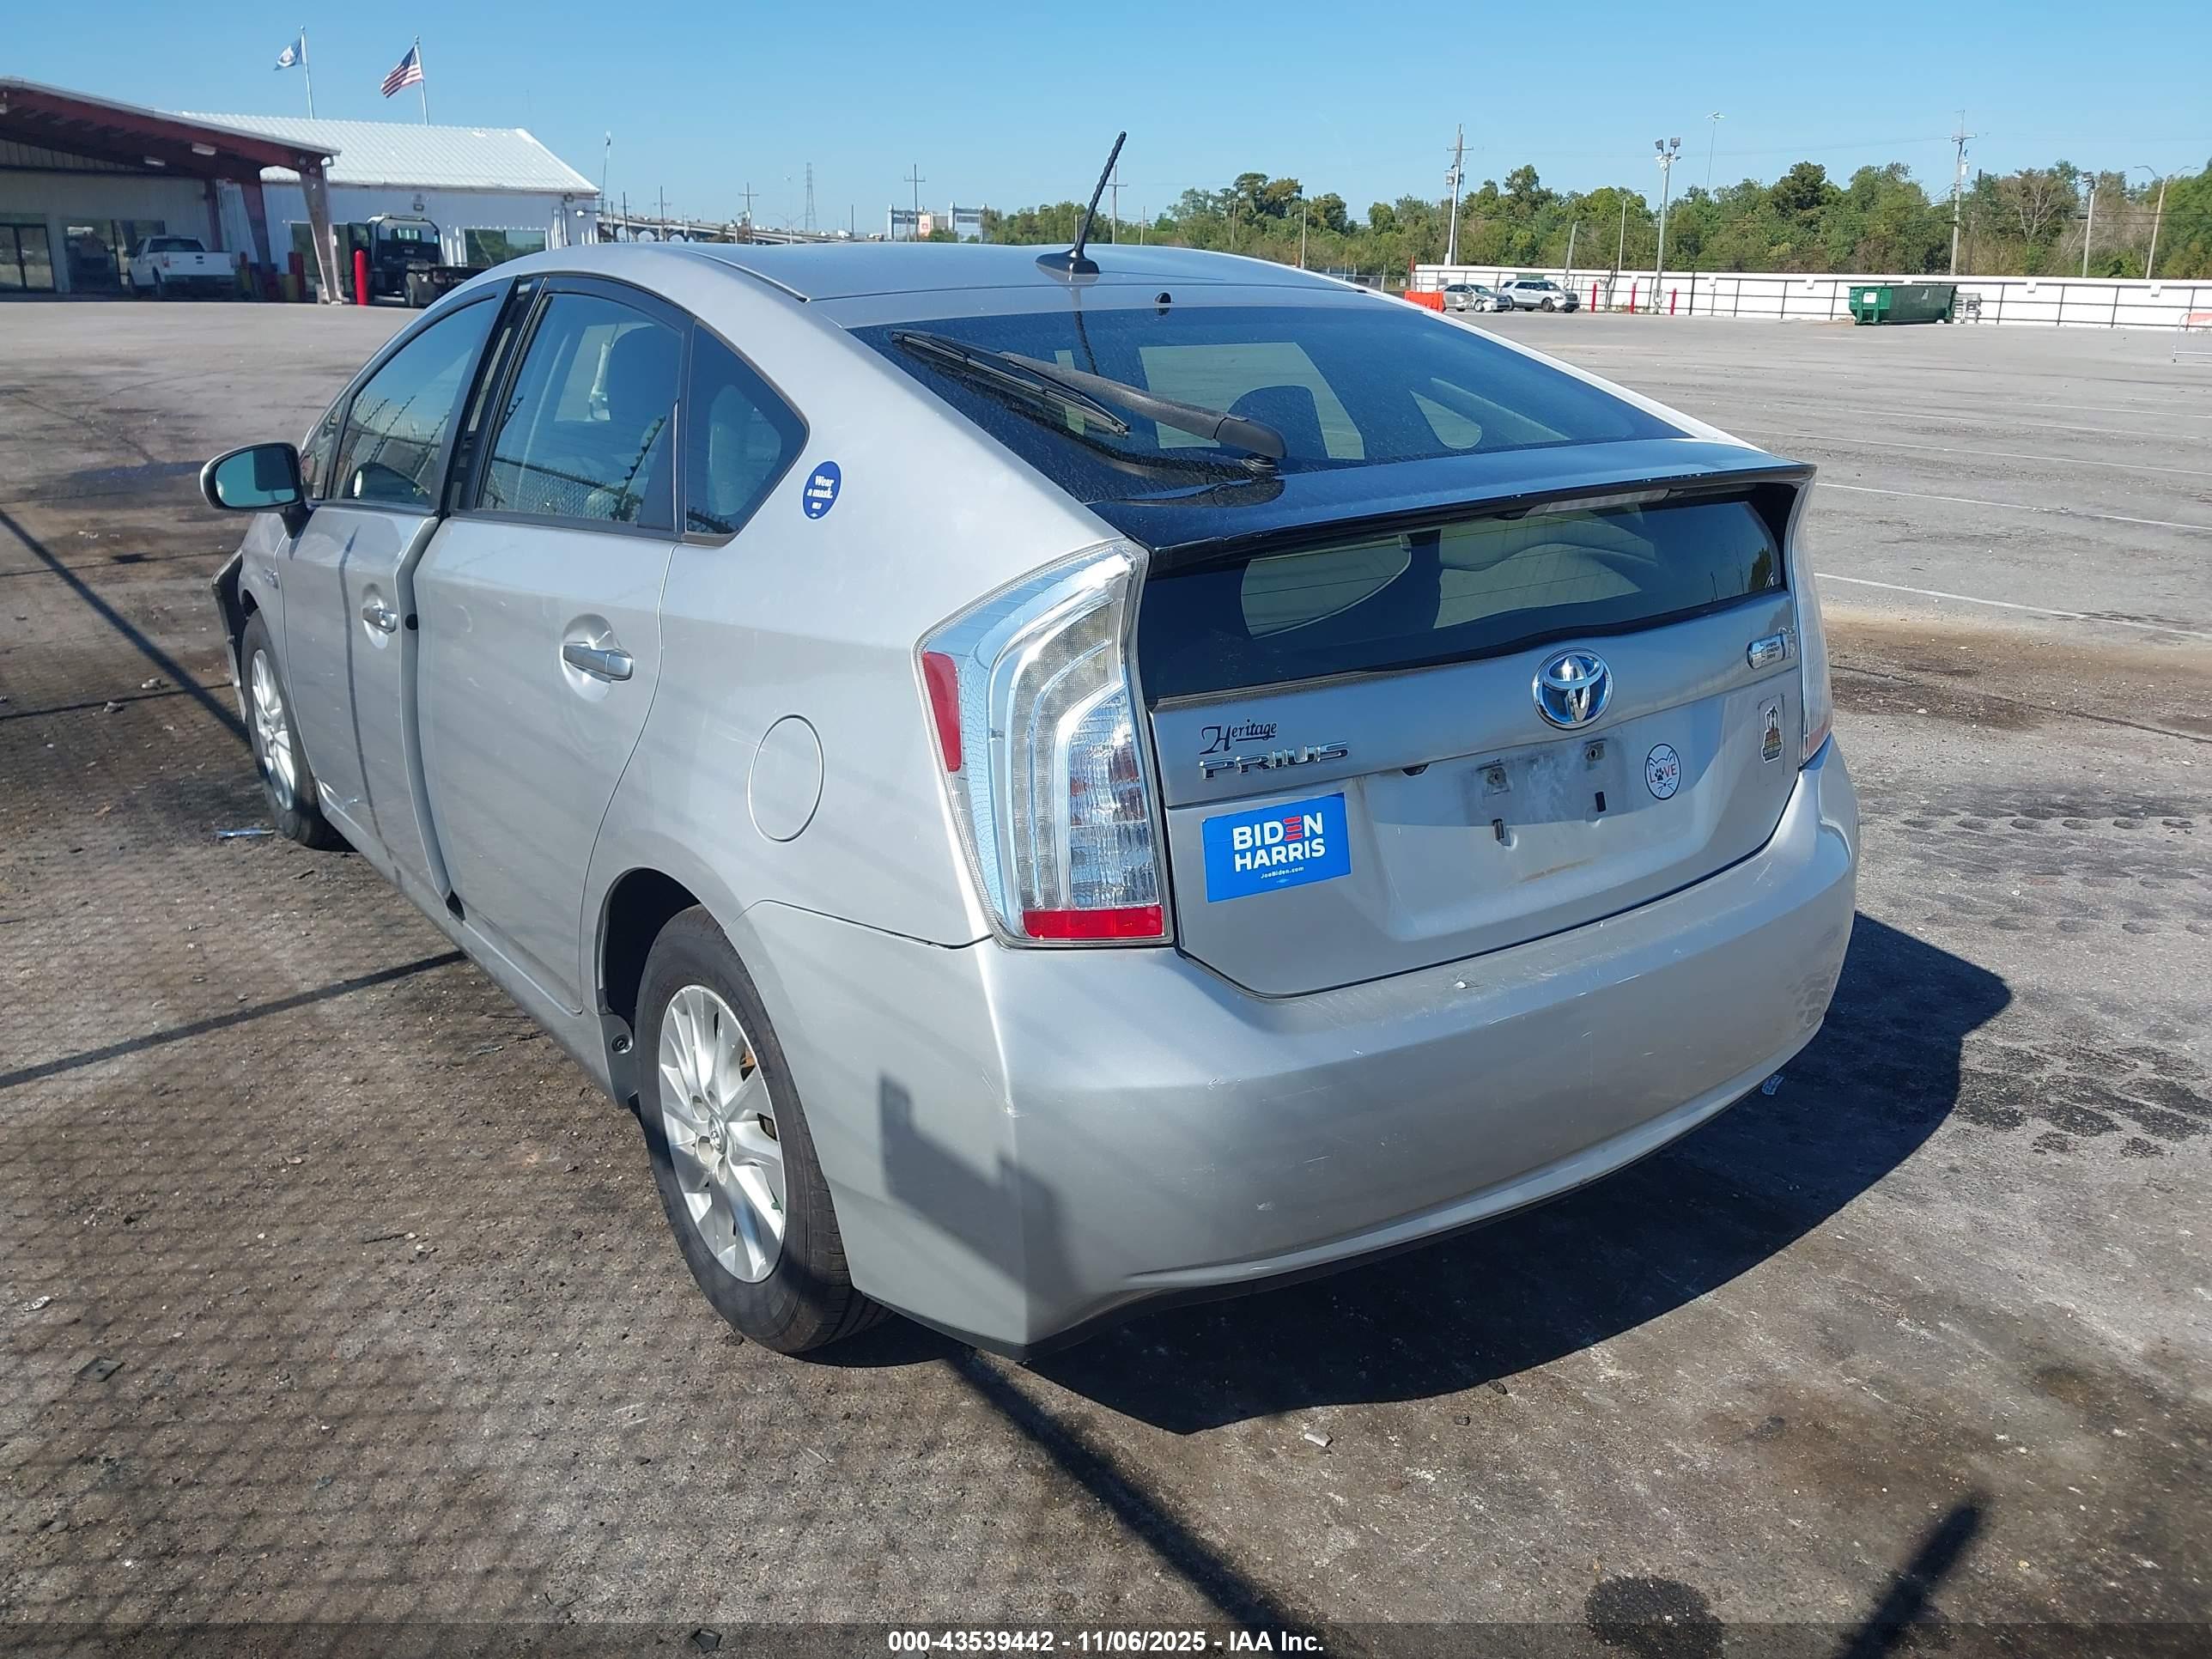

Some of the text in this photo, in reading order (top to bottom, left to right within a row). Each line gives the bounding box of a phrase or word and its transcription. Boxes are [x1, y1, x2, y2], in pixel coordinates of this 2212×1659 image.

[815, 475, 835, 488] Wear
[1199, 719, 1278, 756] Heritage
[1200, 741, 1349, 780] PRIUS
[1232, 811, 1324, 851] BIDEN
[1234, 837, 1327, 872] HARRIS
